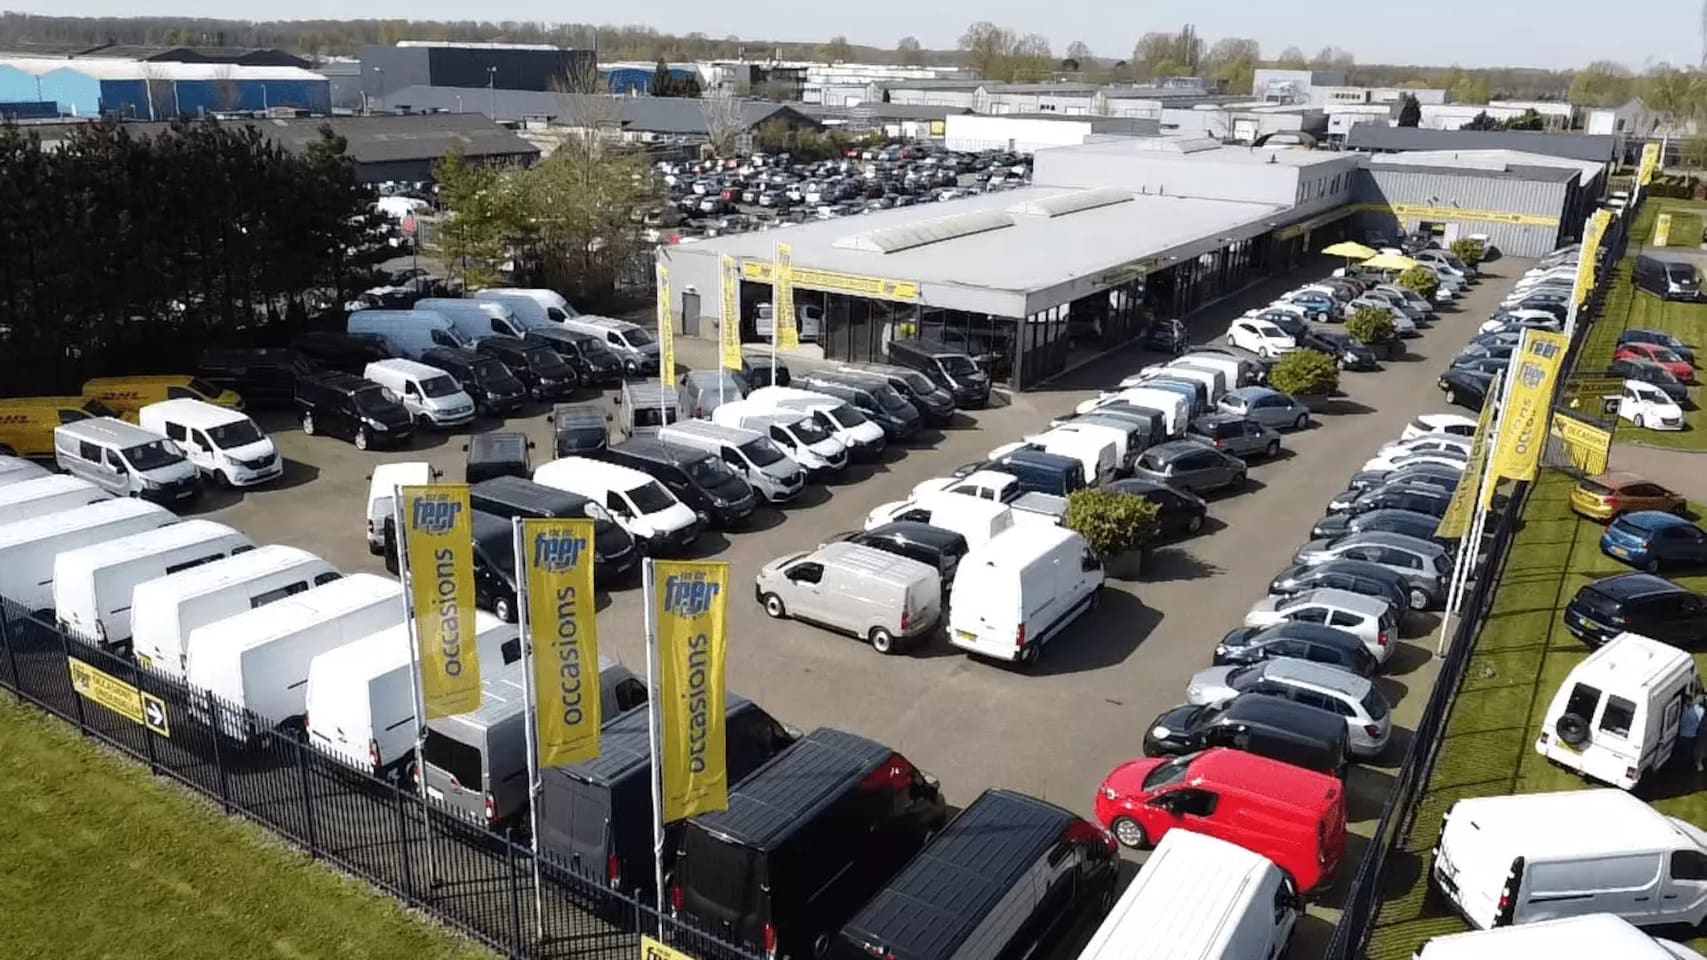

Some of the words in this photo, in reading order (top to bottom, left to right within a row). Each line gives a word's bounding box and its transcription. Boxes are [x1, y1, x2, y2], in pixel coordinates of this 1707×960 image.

[412, 496, 462, 531] feer
[535, 533, 586, 568] feer
[433, 548, 461, 677] occasions
[665, 576, 719, 613] feer
[552, 586, 583, 726] occasions
[682, 633, 708, 773] occasions
